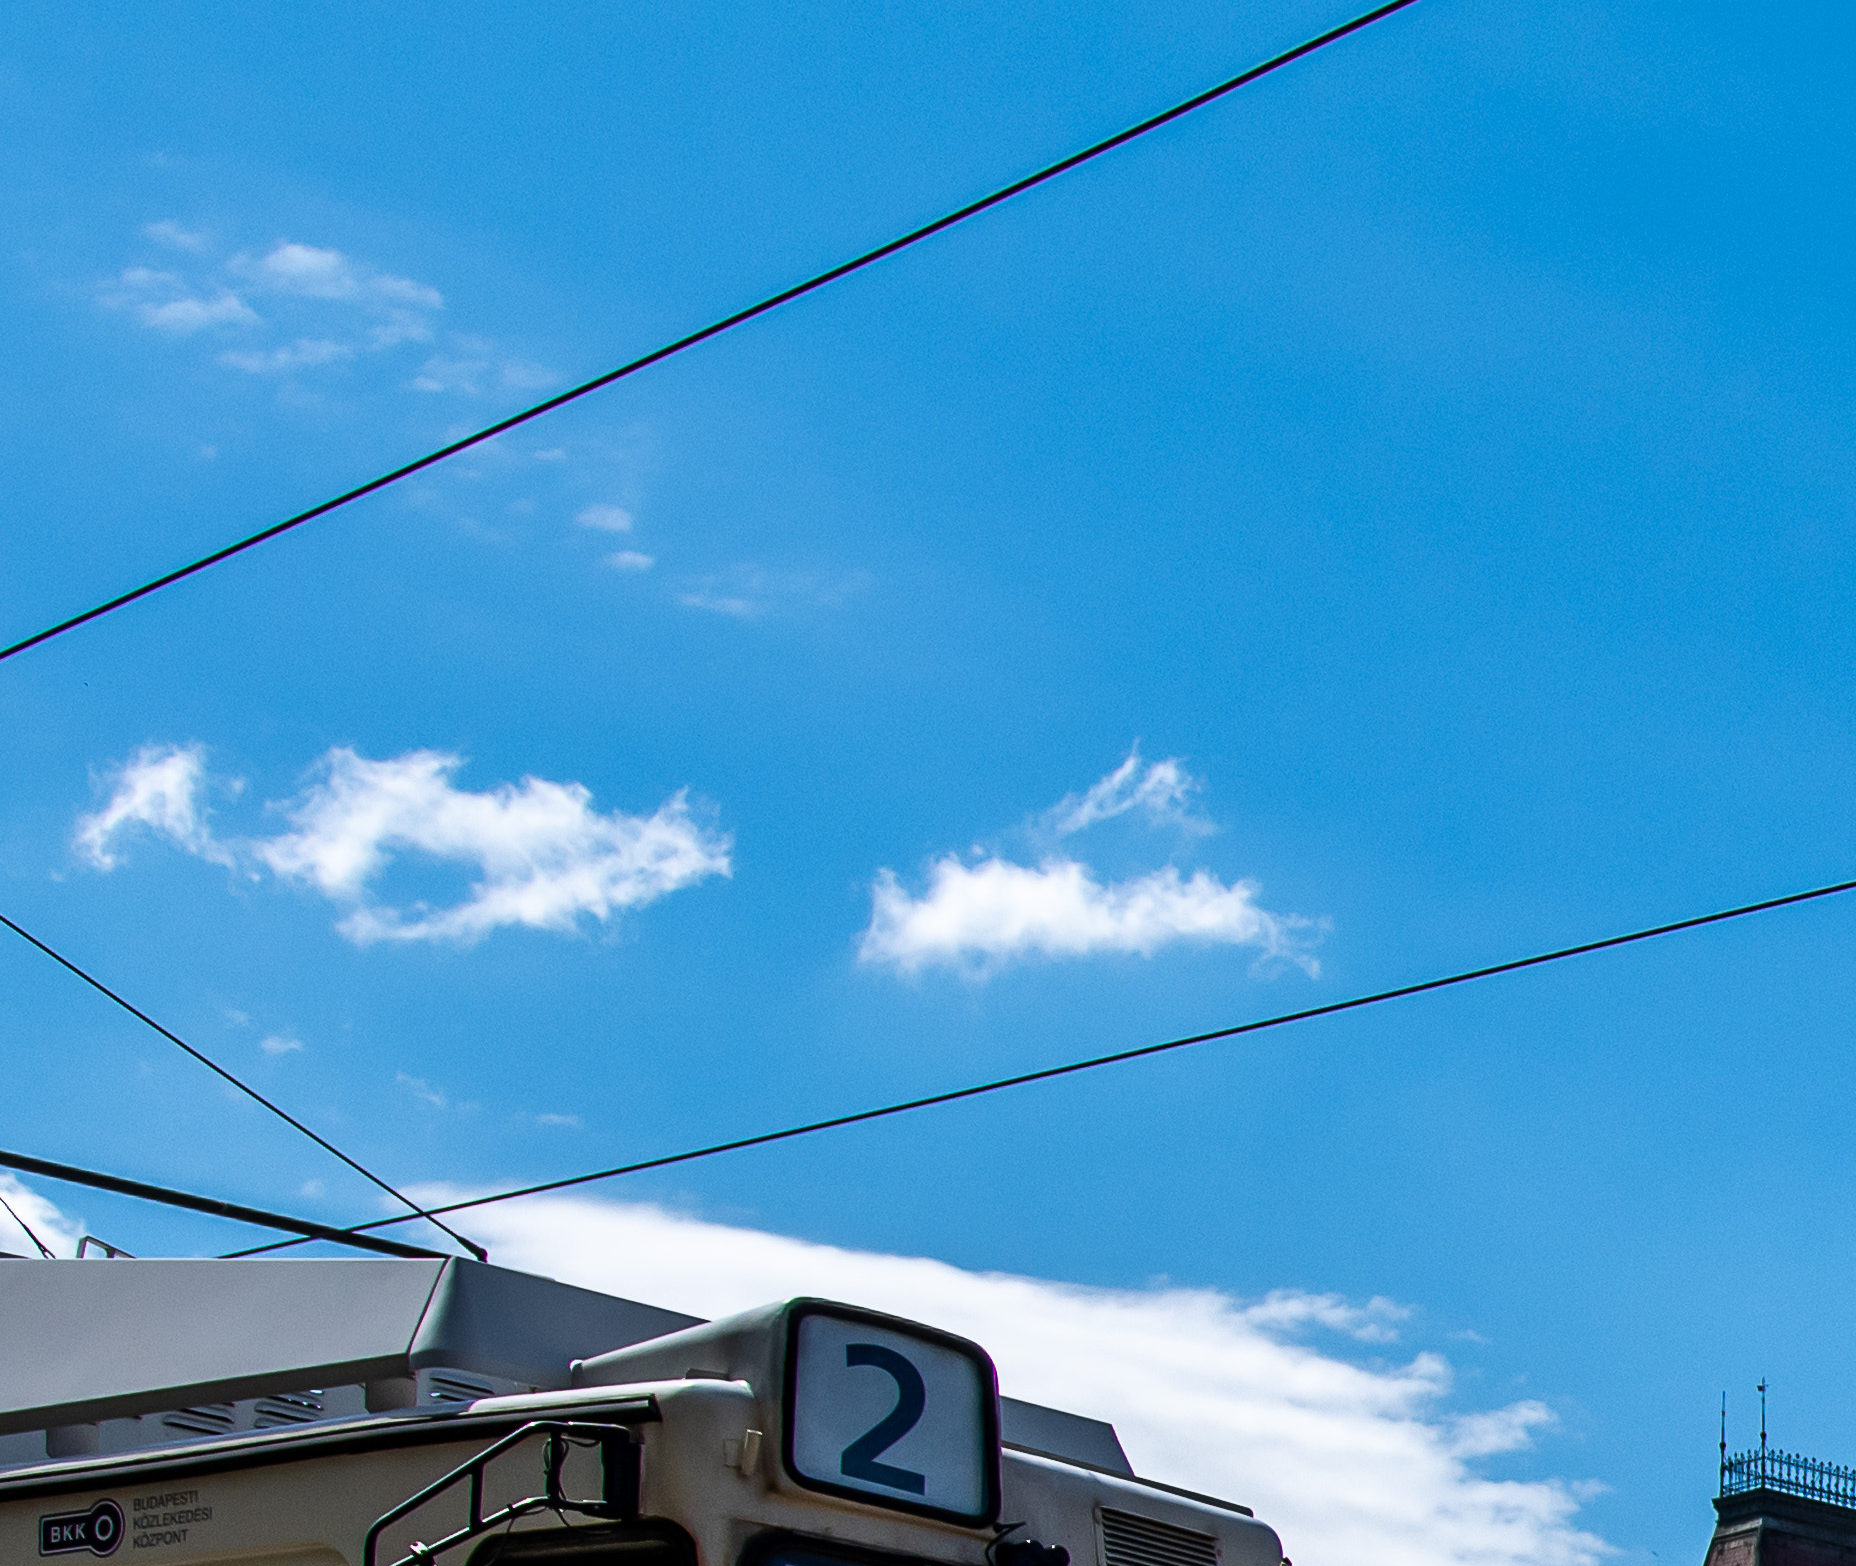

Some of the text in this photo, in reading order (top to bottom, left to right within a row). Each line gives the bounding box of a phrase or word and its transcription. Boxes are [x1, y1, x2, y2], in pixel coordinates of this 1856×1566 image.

[840, 1343, 926, 1497] 2
[133, 1490, 199, 1511] BUDAPESTI
[51, 1523, 86, 1543] BKK
[132, 1529, 189, 1550] KÖZPONT
